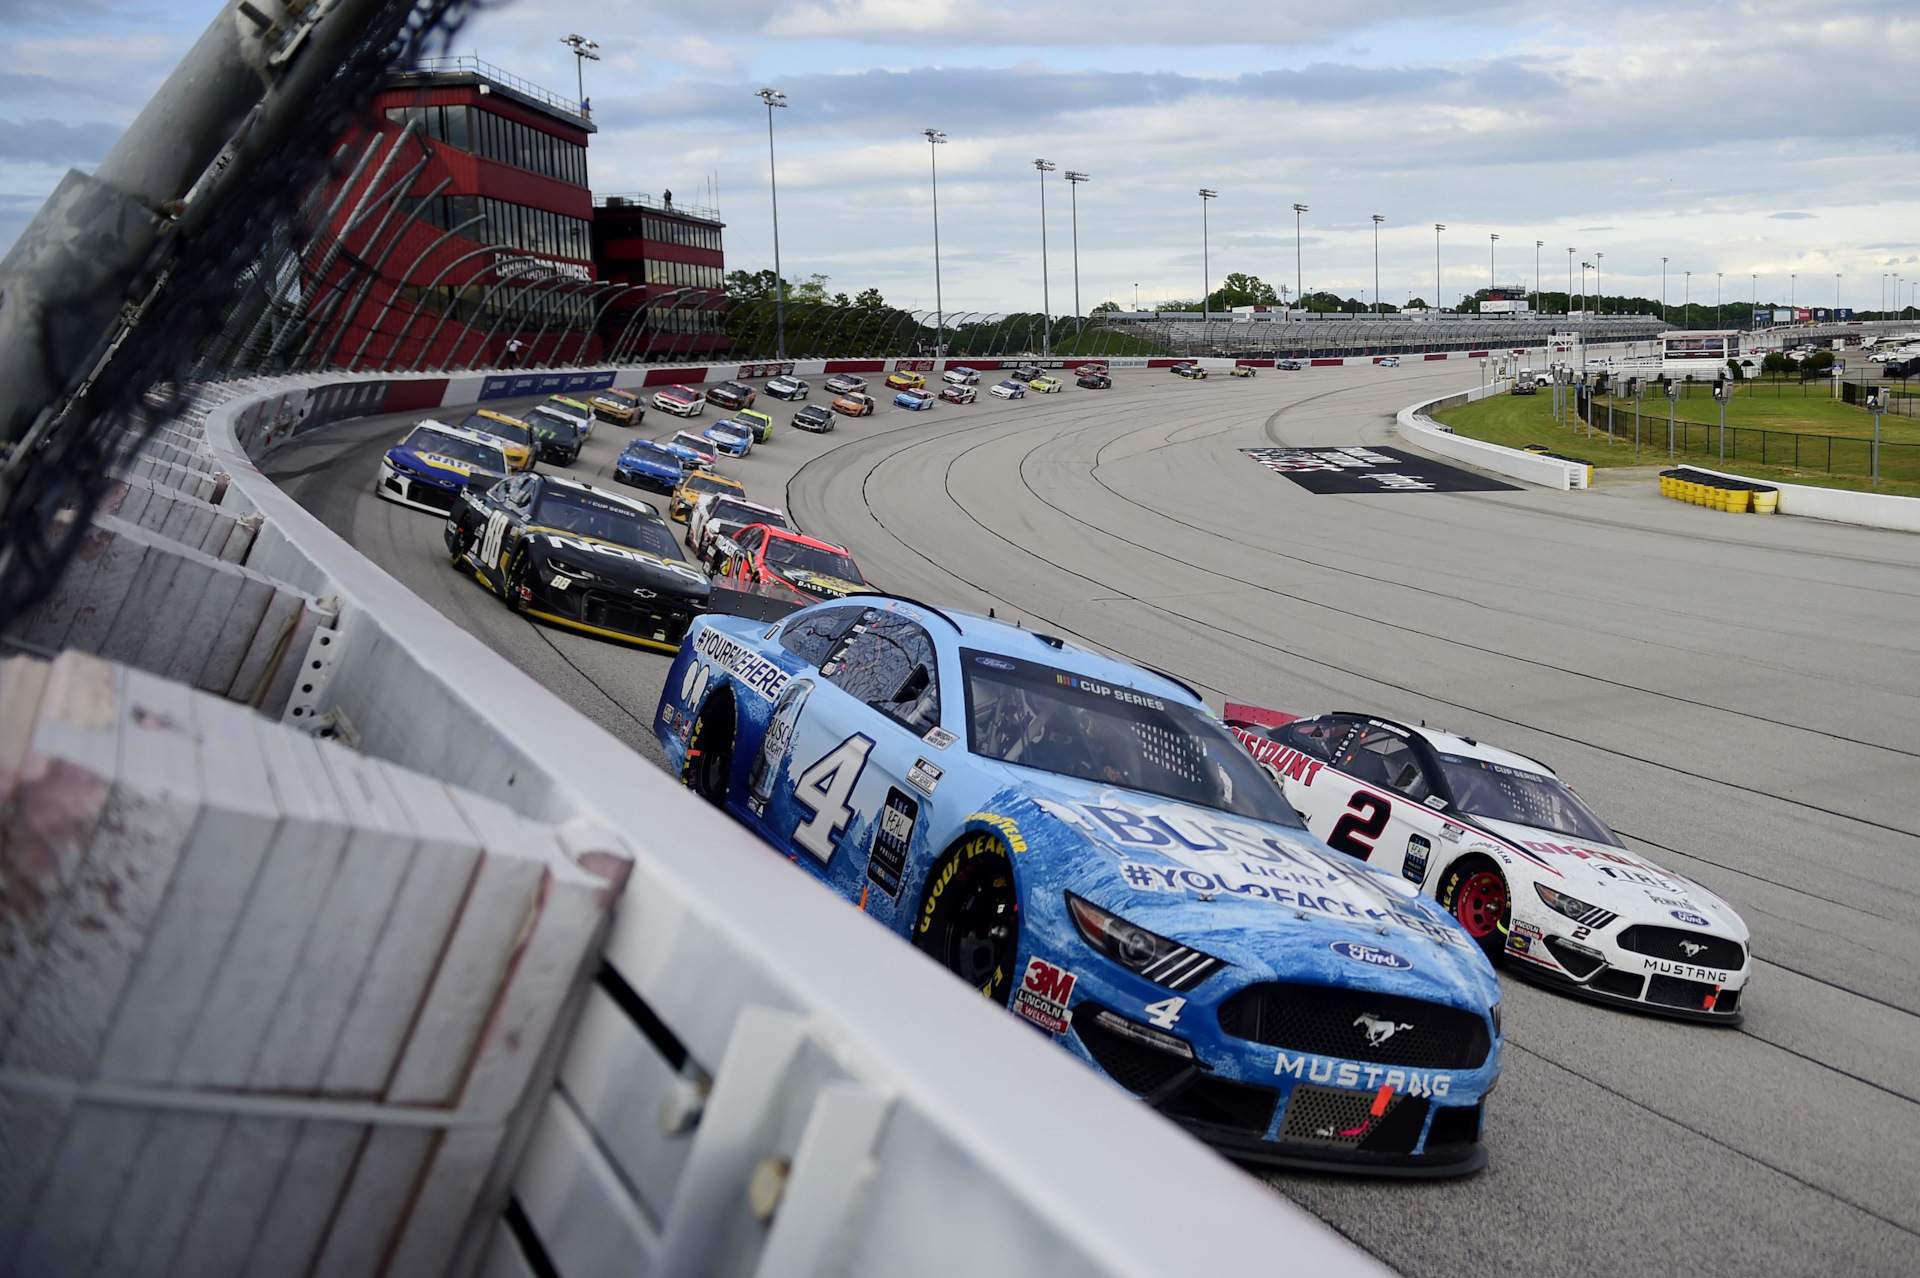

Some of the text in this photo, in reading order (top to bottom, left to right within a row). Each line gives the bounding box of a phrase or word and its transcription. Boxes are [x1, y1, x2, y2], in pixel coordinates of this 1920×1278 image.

[481, 509, 509, 570] 88
[551, 574, 572, 591] 88
[797, 580, 823, 592] BASS
[1080, 680, 1165, 711] CUP SERIES
[766, 717, 794, 749] BUSCH
[765, 739, 783, 758] LIGHT
[793, 732, 877, 864] 4
[963, 812, 1028, 853] GOODYEAR
[1327, 789, 1391, 862] 2
[1240, 862, 1326, 889] LIGHT
[1571, 924, 1592, 941] 2
[1345, 942, 1403, 969] Ford
[1025, 961, 1075, 1006] 3M
[1643, 959, 1728, 983] MUSTANG
[1017, 990, 1063, 1019] LINCOLN
[1023, 1006, 1062, 1031] WELDERS
[1144, 996, 1188, 1030] 4
[1274, 1052, 1451, 1098] MUSTANG
